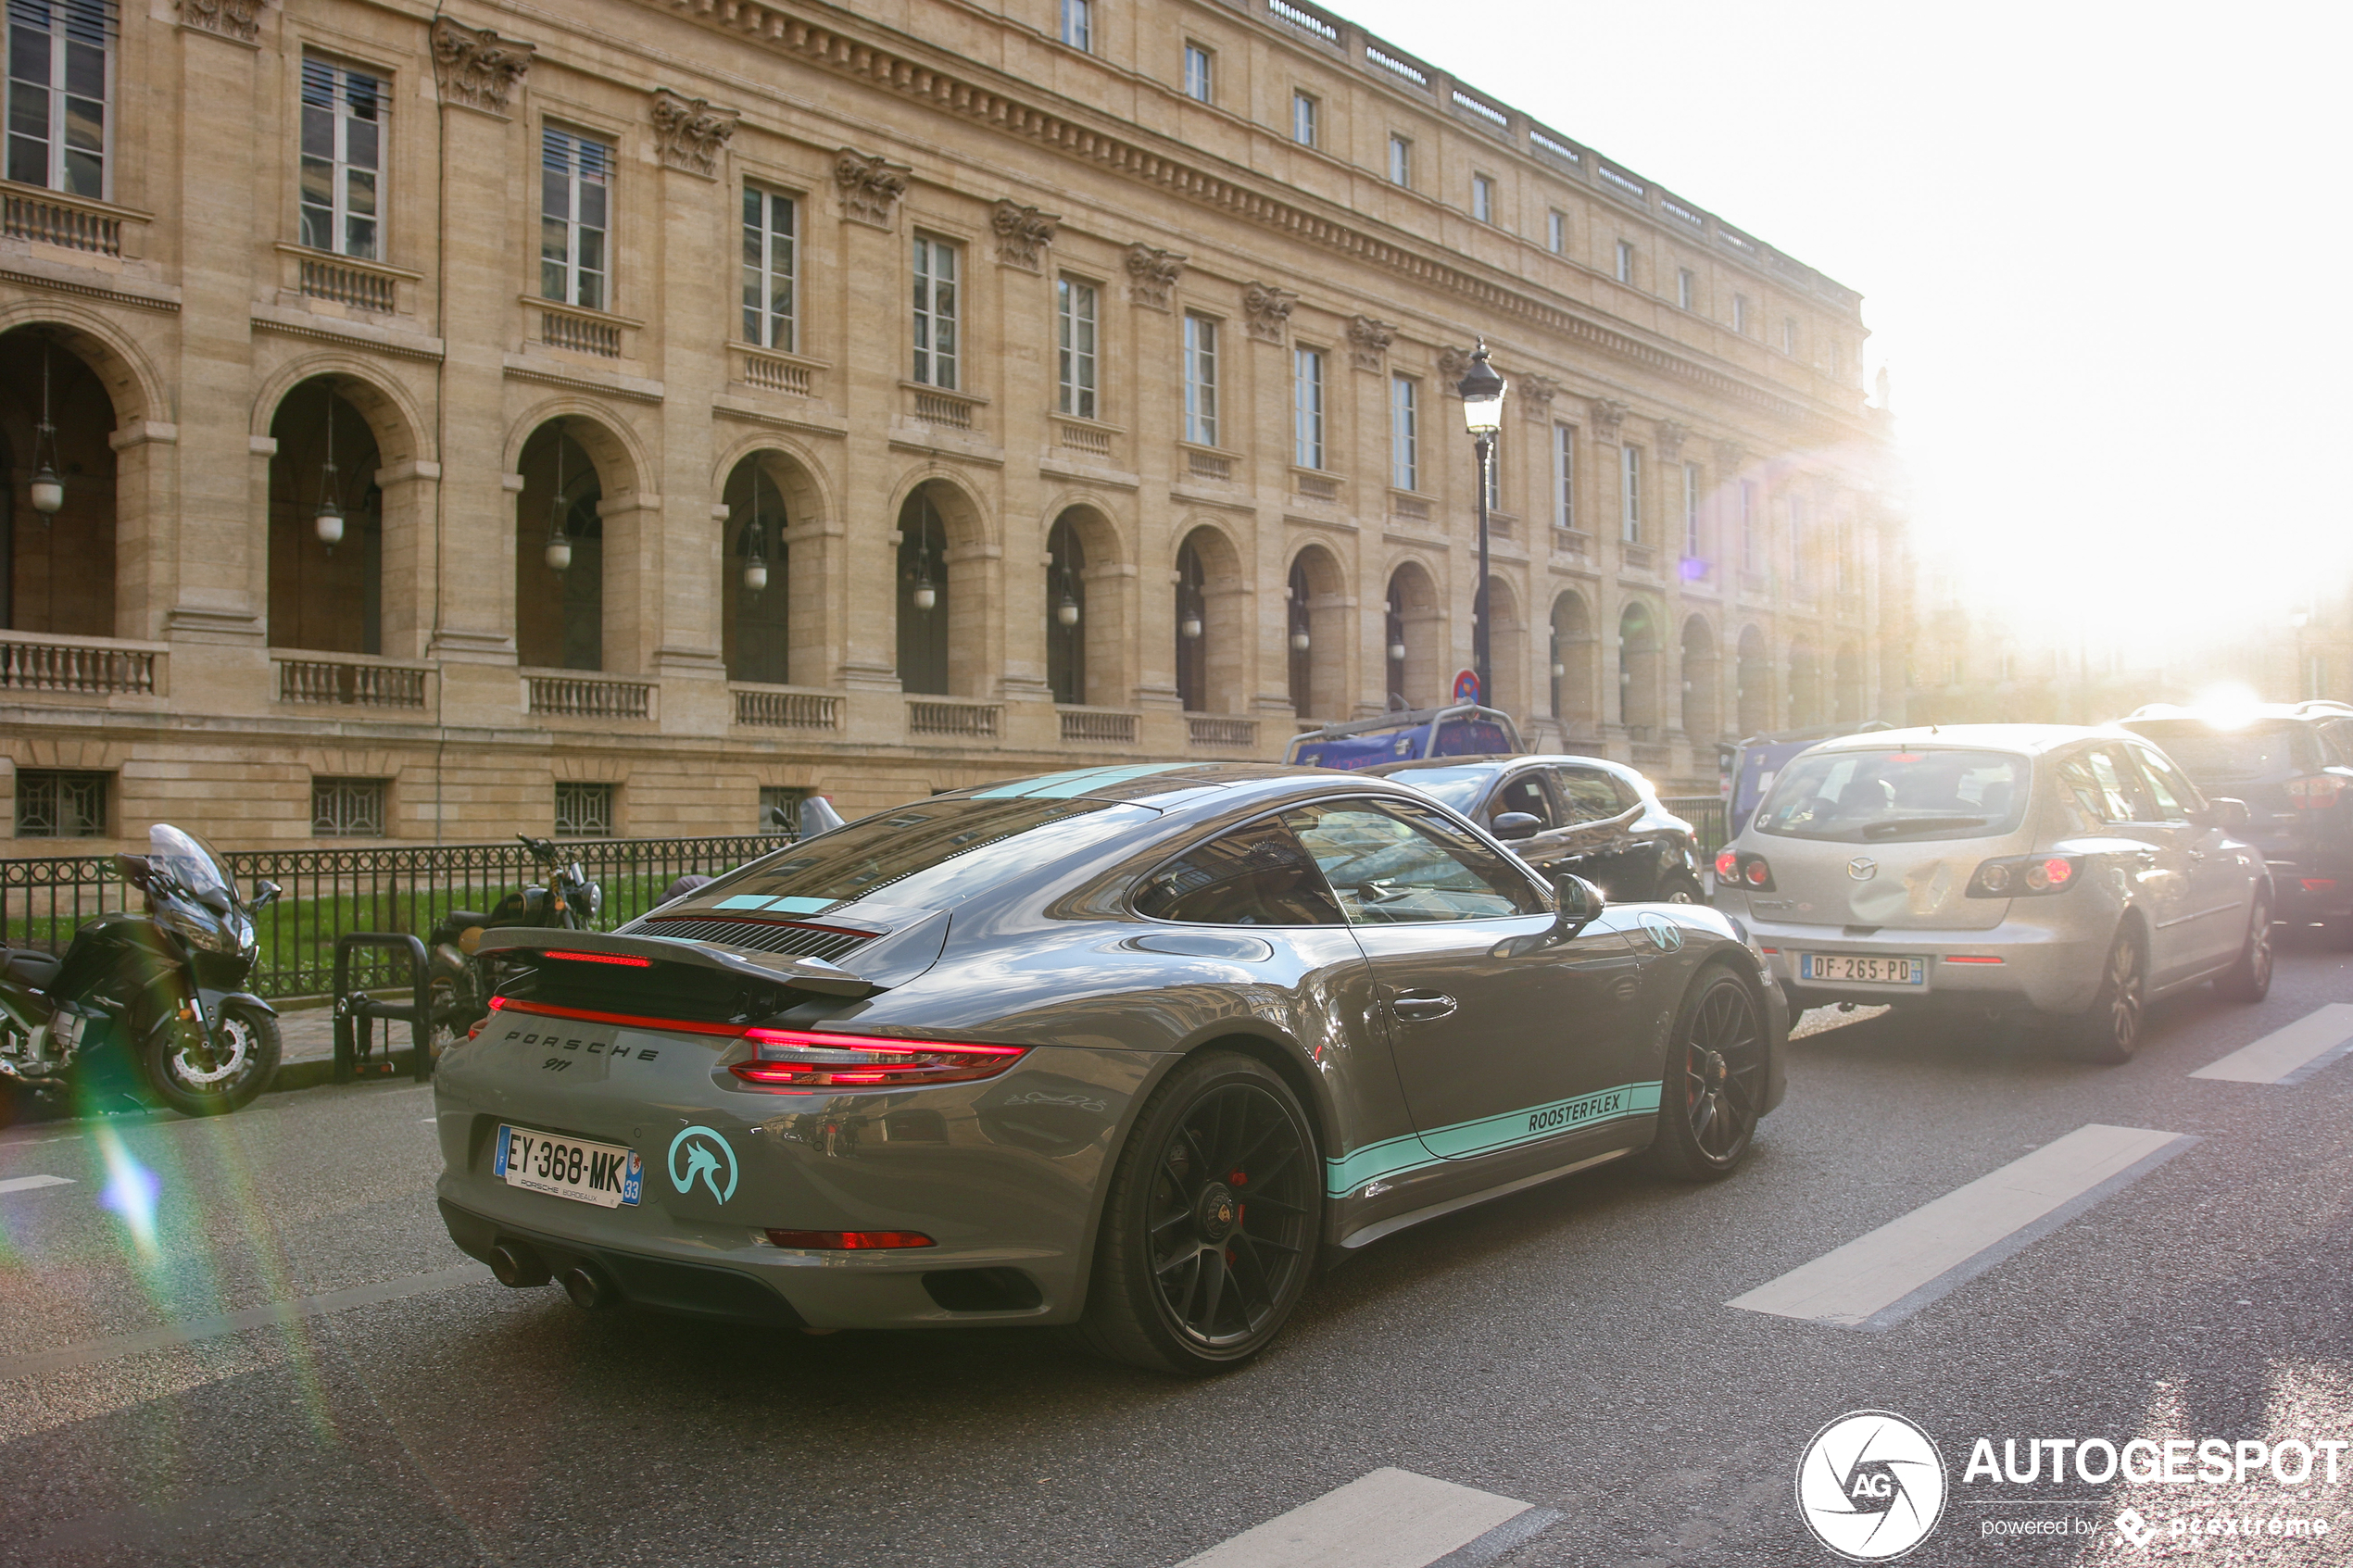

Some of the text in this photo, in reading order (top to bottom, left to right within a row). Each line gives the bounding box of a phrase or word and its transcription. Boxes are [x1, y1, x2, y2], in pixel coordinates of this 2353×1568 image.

[505, 1031, 660, 1062] PORSCHE
[542, 1058, 573, 1073] 911
[1529, 1094, 1621, 1132] ROOSTER FLEX
[507, 1134, 626, 1194] EY-368-MK
[521, 1179, 598, 1202] PORSCHE BORDEAUX
[624, 1180, 639, 1199] 33
